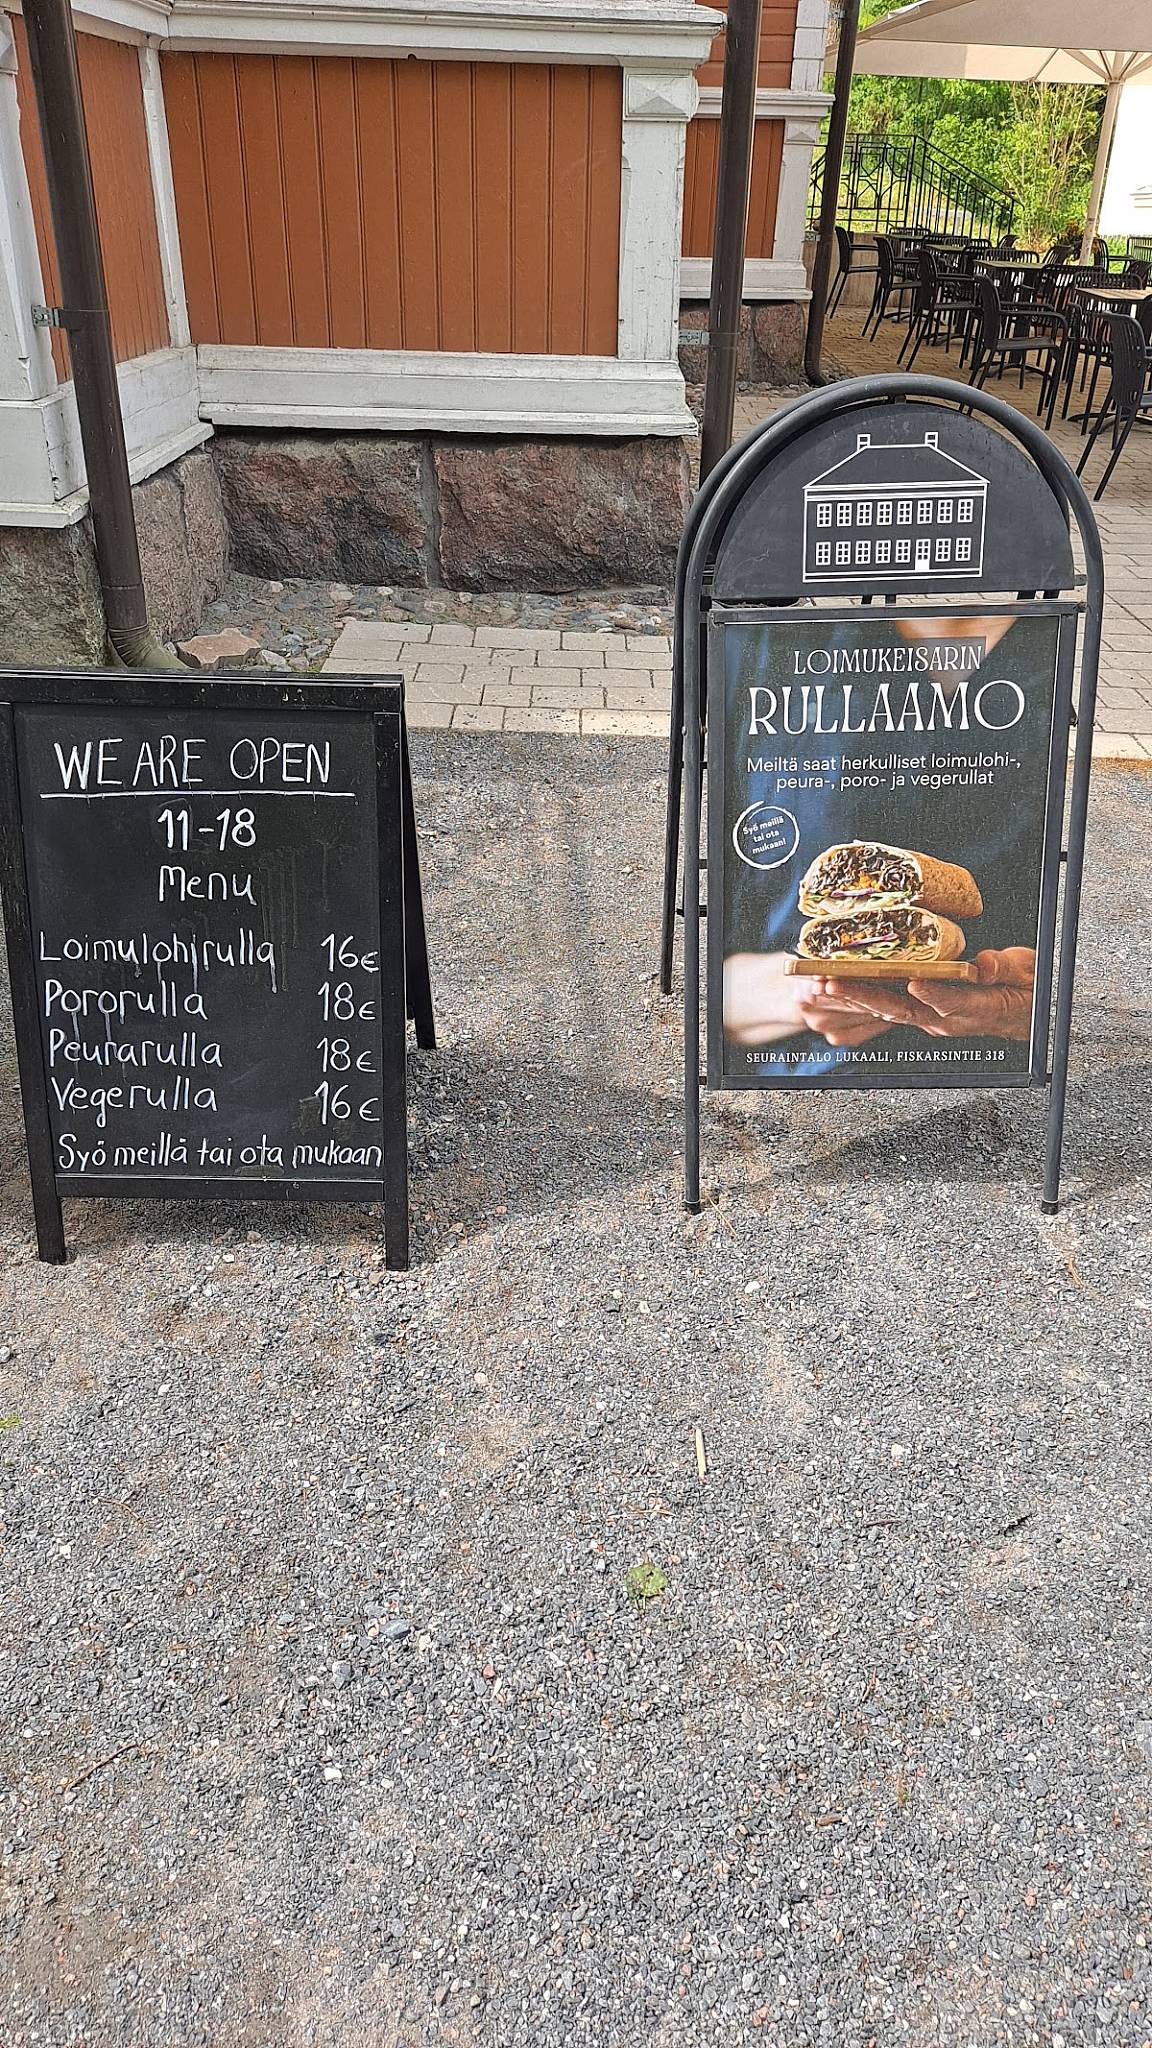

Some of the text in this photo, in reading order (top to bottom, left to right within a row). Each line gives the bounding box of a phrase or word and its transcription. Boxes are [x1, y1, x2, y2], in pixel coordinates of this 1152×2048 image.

[793, 644, 983, 675] LOIMUKEISARIN
[748, 679, 1026, 735] RULLAAMO
[53, 735, 331, 790] WE ARE OPEN
[747, 751, 1021, 773] Meiltä saat herkulliset loimulohi-,
[776, 769, 994, 792] peura-, poro- ja vegerullat
[157, 808, 257, 851] 11-18
[743, 816, 784, 835] Syö meillä
[753, 829, 780, 842] tai ota
[752, 838, 786, 854] mukaan!
[158, 865, 257, 906] Menu
[44, 979, 208, 1021] Pororulla
[49, 1028, 223, 1068] Peurarulla
[746, 1050, 1005, 1064] SEURAINTALO LUKAALI, FISKARSINTIE 318
[51, 1075, 218, 1128] Vegerulla
[58, 1132, 384, 1172] Syö meillä tai ota mukaan
